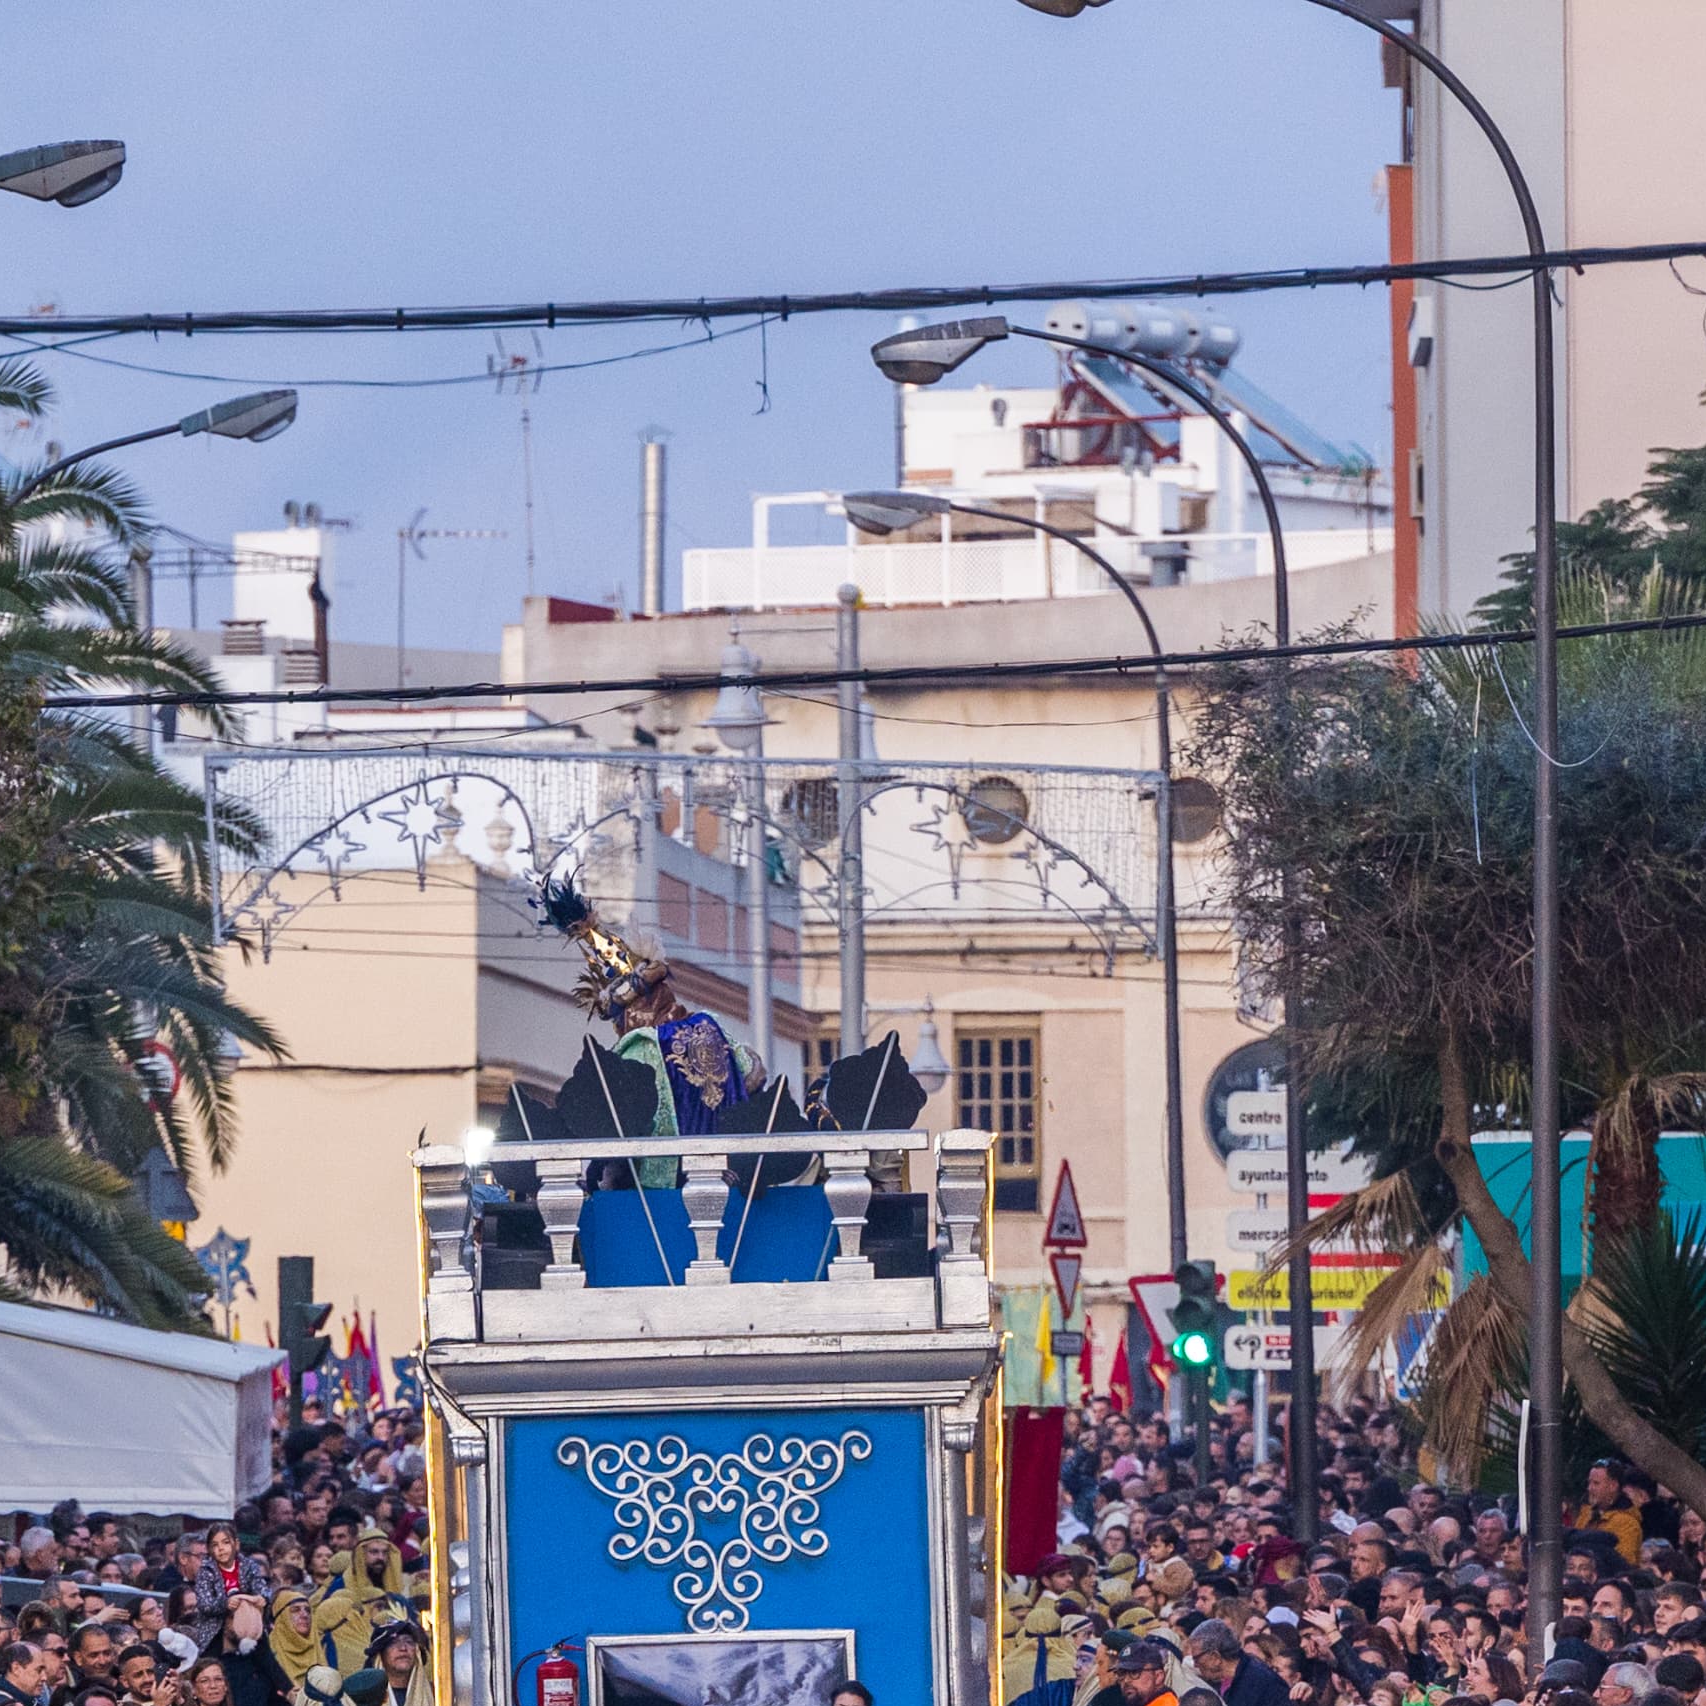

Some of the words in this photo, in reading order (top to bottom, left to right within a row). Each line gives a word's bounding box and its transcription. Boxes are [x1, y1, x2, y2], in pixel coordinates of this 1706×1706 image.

[1239, 1111, 1282, 1125] centro
[1238, 1169, 1329, 1185] ayuntanto
[1238, 1228, 1290, 1242] mercad
